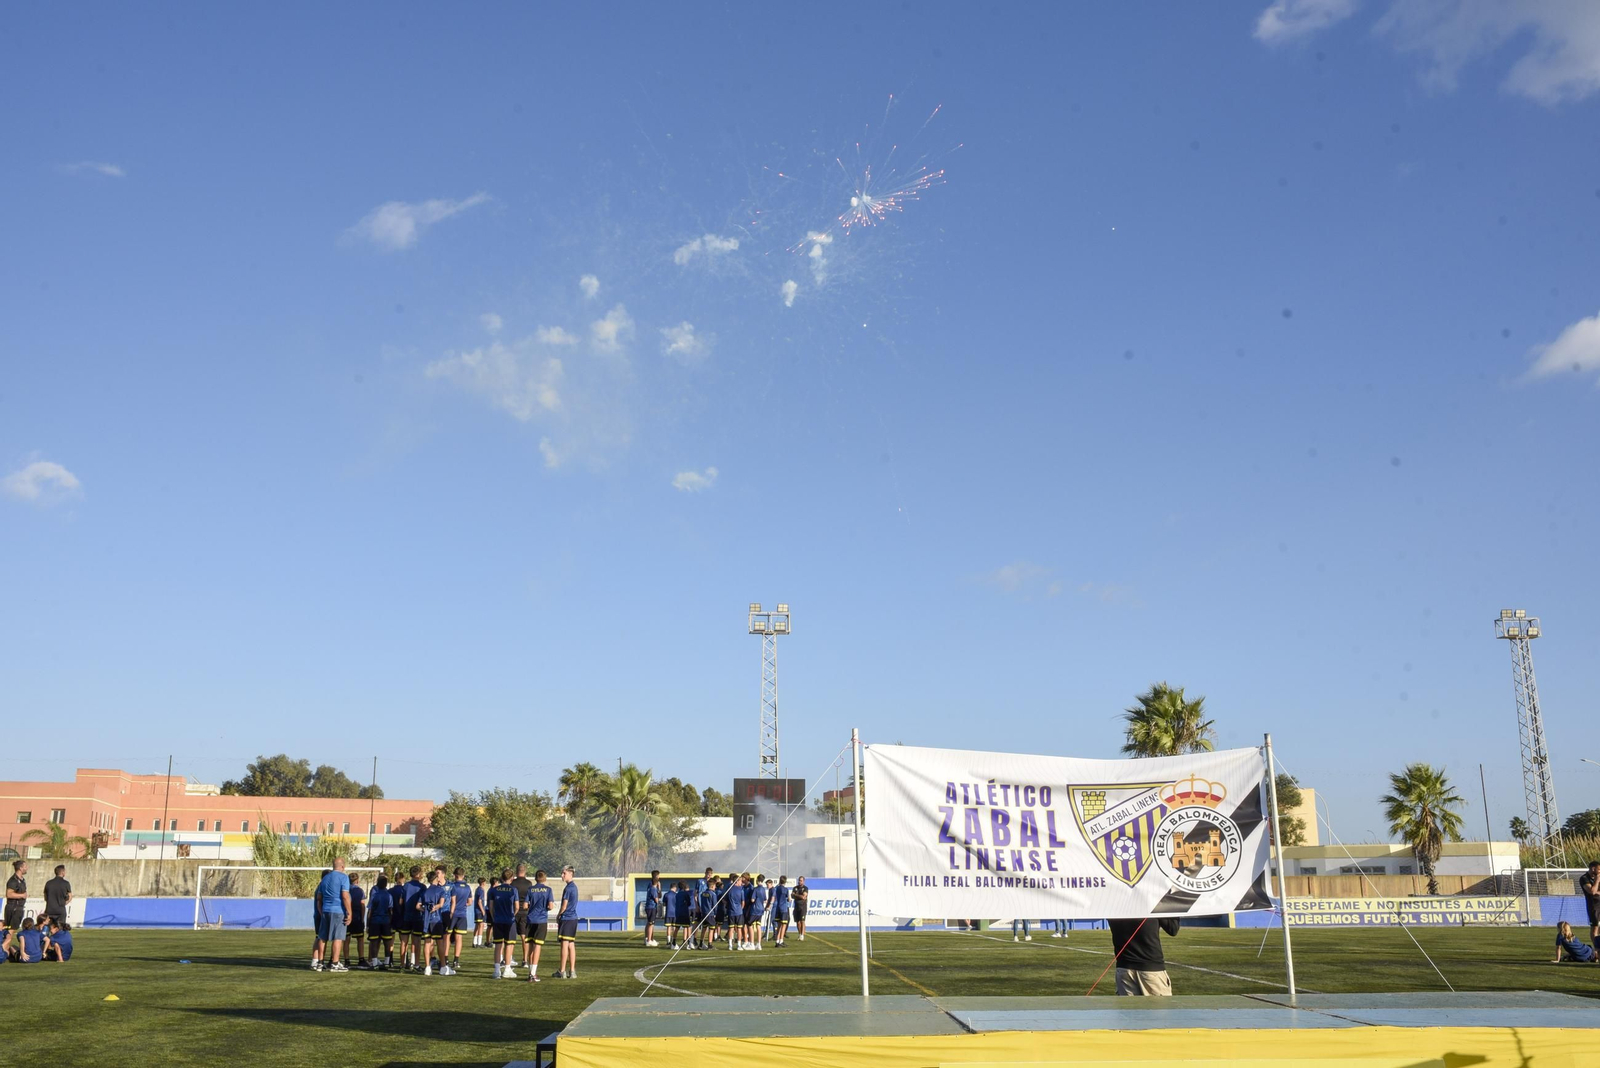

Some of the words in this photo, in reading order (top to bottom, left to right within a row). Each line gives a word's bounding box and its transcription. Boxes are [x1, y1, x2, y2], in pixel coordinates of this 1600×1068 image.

[945, 778, 1052, 808] ATLÉTICO
[1089, 822, 1107, 836] ATL.
[1106, 808, 1132, 826] ZABAL
[1133, 791, 1159, 813] LINENS
[938, 805, 1066, 848] ZABAL
[1157, 825, 1171, 857] REAL
[1170, 810, 1238, 854] BALOMPÉDICA
[949, 845, 1059, 872] LINENSE
[903, 875, 938, 888] FILIAL
[943, 875, 970, 888] REAL
[975, 875, 1056, 889] BALOMPÉDICA
[1060, 876, 1106, 889] LINENSE
[1175, 873, 1225, 889] LINENSE
[809, 899, 822, 908] DE
[825, 897, 859, 908] FÚTBO
[1286, 899, 1360, 911] RESPÉTAME
[1364, 900, 1372, 909] Y
[1377, 900, 1395, 909] NO
[1399, 900, 1461, 909] INSULTES
[1465, 900, 1476, 909] A
[1477, 899, 1516, 909] NADIE
[832, 908, 859, 916] GONZÁL
[1287, 913, 1360, 925] QUEREMOS
[1363, 913, 1417, 924] FUTBOL
[1420, 913, 1442, 923] SIN
[1445, 912, 1517, 923] VIOLENCIA
